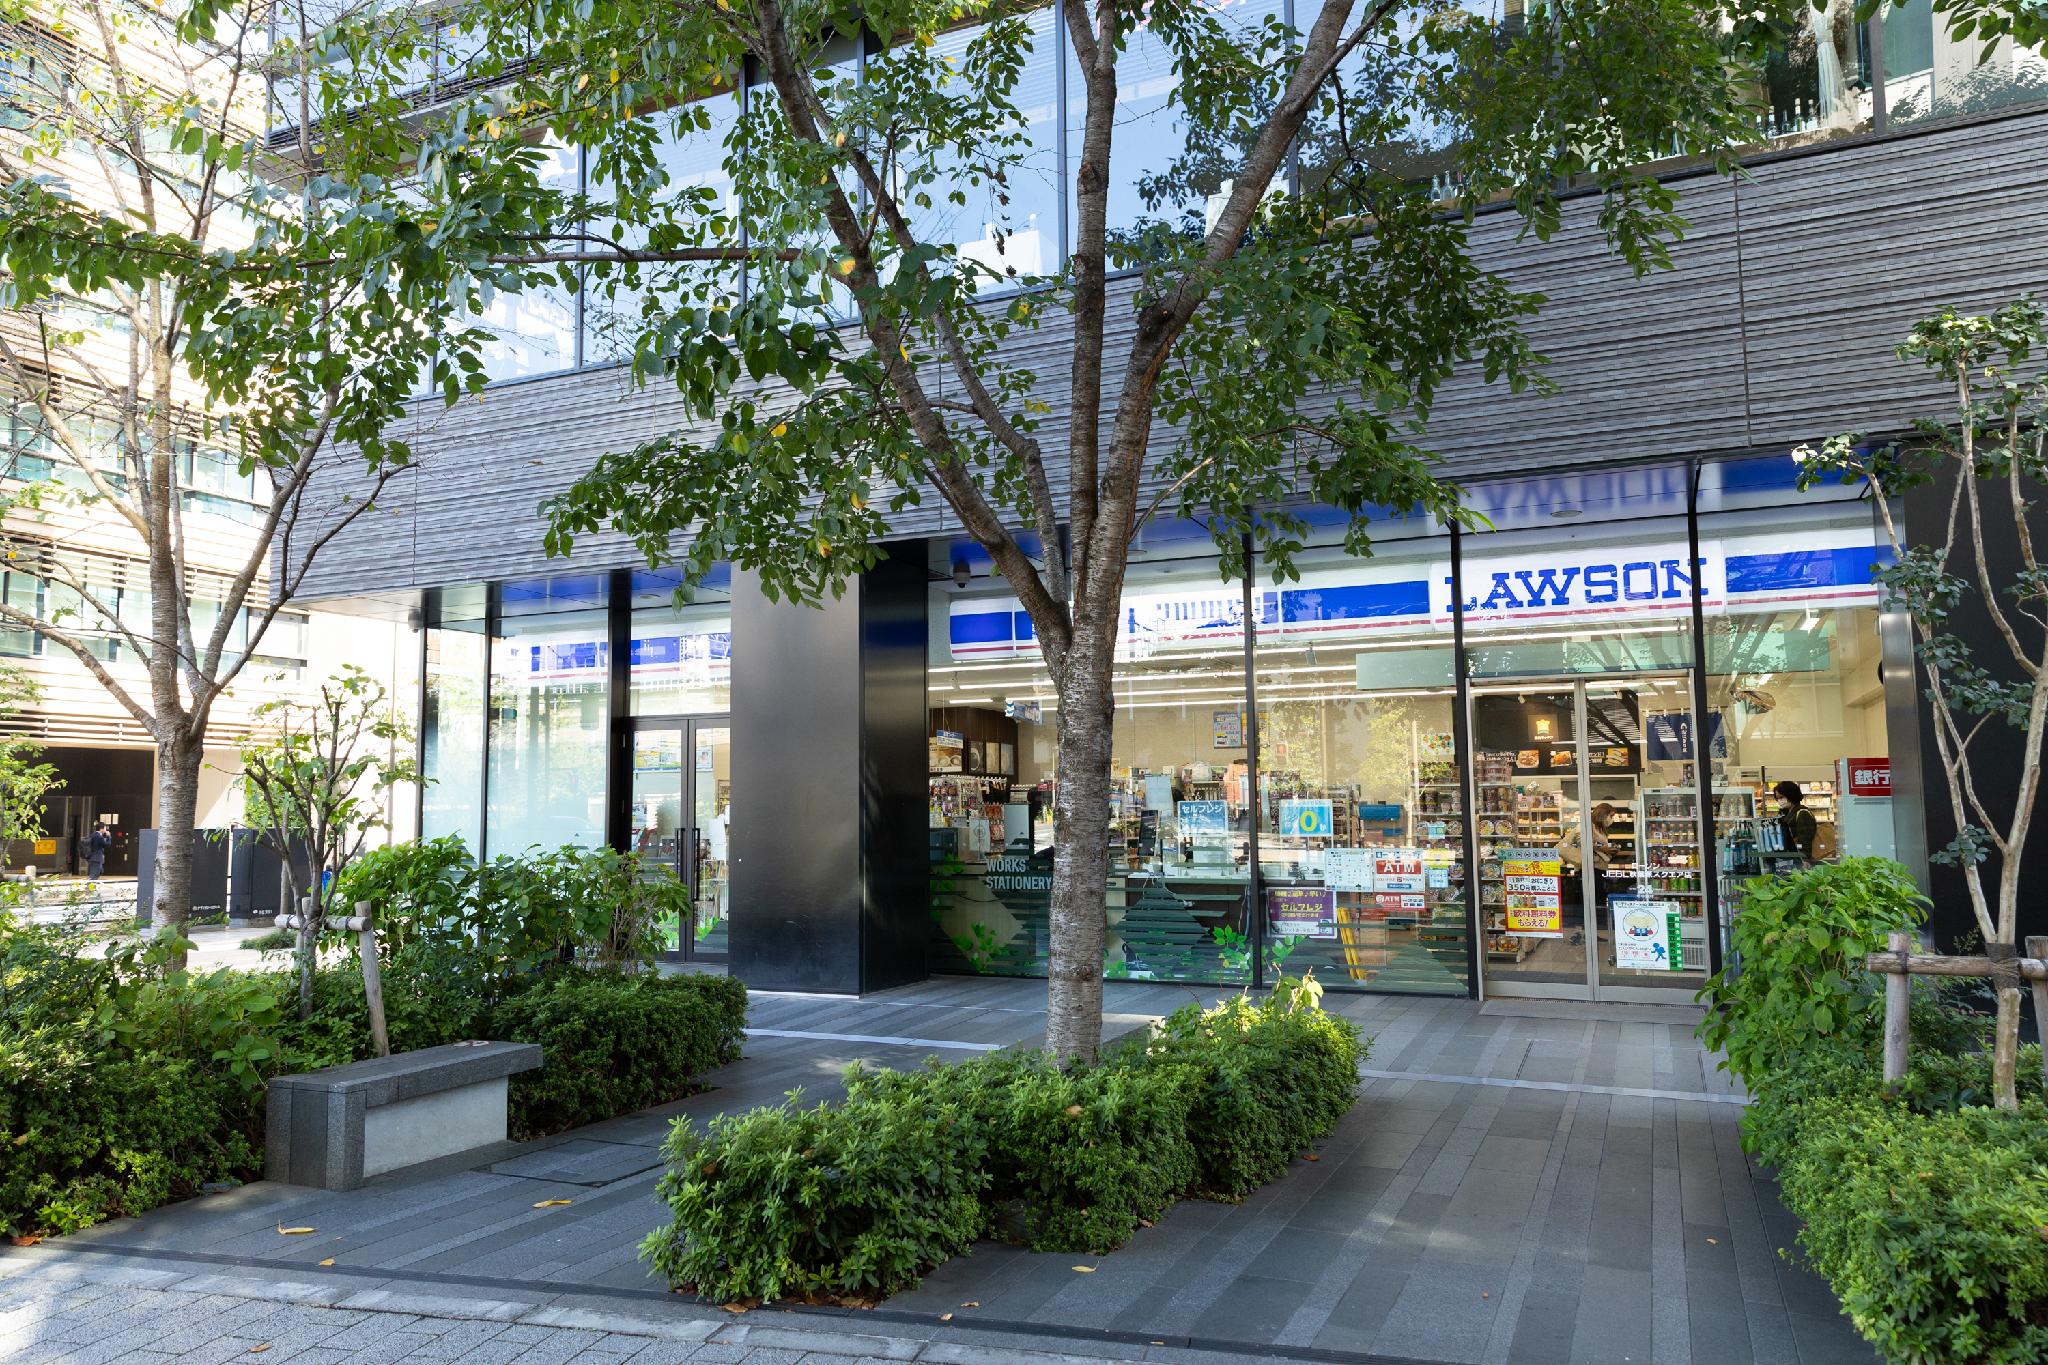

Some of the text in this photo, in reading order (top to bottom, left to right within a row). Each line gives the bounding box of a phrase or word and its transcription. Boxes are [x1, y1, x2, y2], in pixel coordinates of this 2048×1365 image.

[1445, 557, 1708, 612] LAWSON
[1855, 769, 1890, 784] 銀行
[1182, 804, 1222, 813] セルフレジ
[986, 859, 1026, 873] WORKS
[1384, 863, 1415, 872] ATM
[986, 876, 1052, 890] STATIONERY
